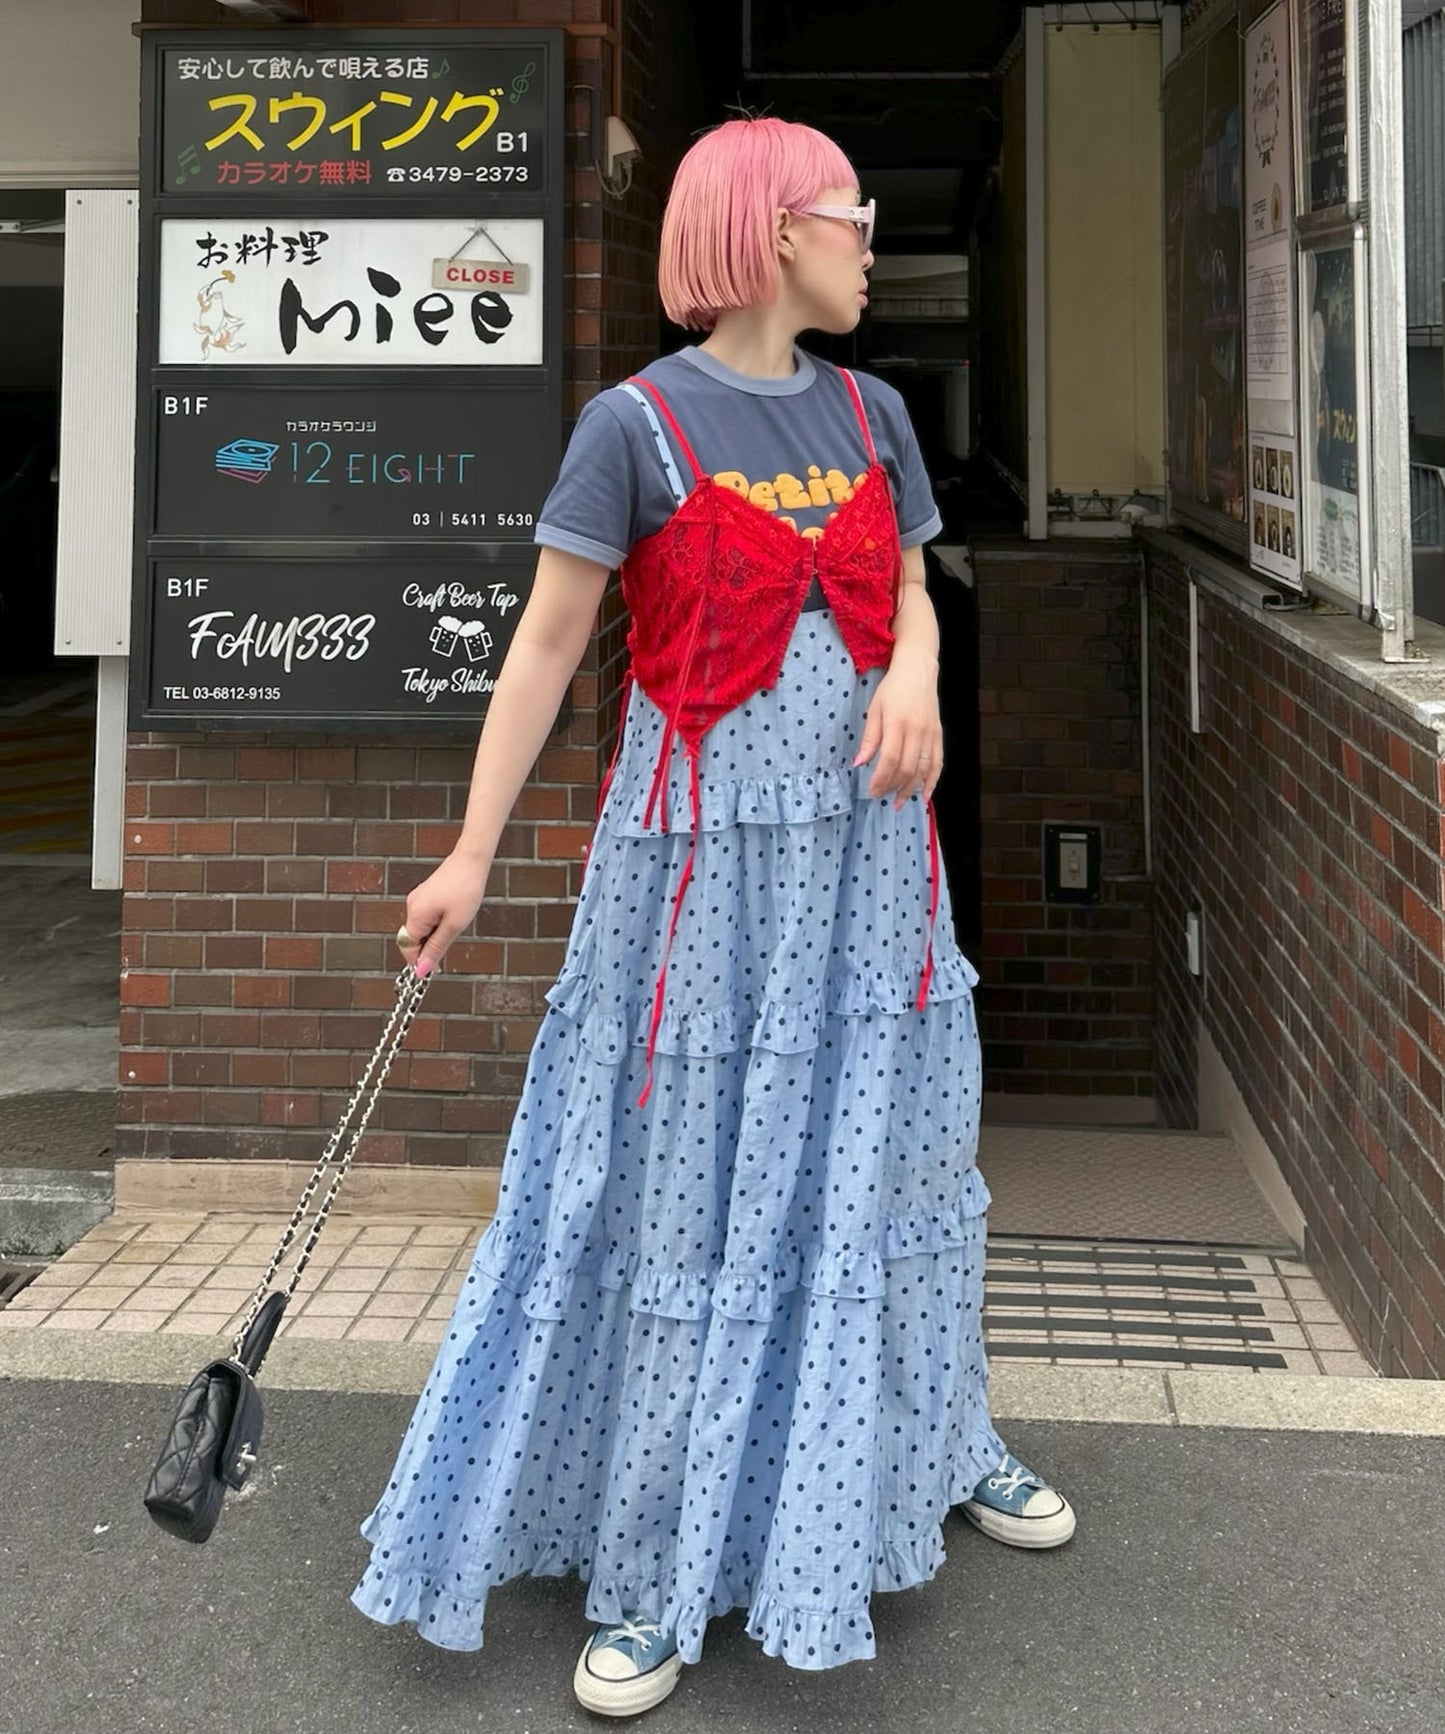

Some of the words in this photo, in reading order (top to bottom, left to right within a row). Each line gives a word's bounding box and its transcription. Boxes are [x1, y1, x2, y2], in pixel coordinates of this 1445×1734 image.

[178, 57, 429, 80] 安心して飲んで唄える店
[205, 87, 504, 151] スウィング
[496, 131, 528, 153] B1
[217, 160, 372, 185] カラオケ無料
[408, 166, 529, 182] 3479-2373
[196, 227, 329, 268] お料理
[446, 267, 515, 284] CLOSE
[164, 396, 209, 415] B1F
[286, 421, 377, 432] カラオケラウンジ
[291, 441, 332, 483] 12
[345, 453, 476, 484] EIGHT
[412, 512, 431, 526] 03
[451, 513, 487, 526] 5411
[497, 513, 533, 526] 5630
[167, 578, 209, 597] B1F
[402, 582, 447, 612] Craft
[447, 582, 485, 607] Beer
[487, 583, 519, 616] Tap
[163, 686, 188, 700] TEL
[192, 686, 281, 700] 03-6812-9135
[401, 667, 449, 703] Tokyo
